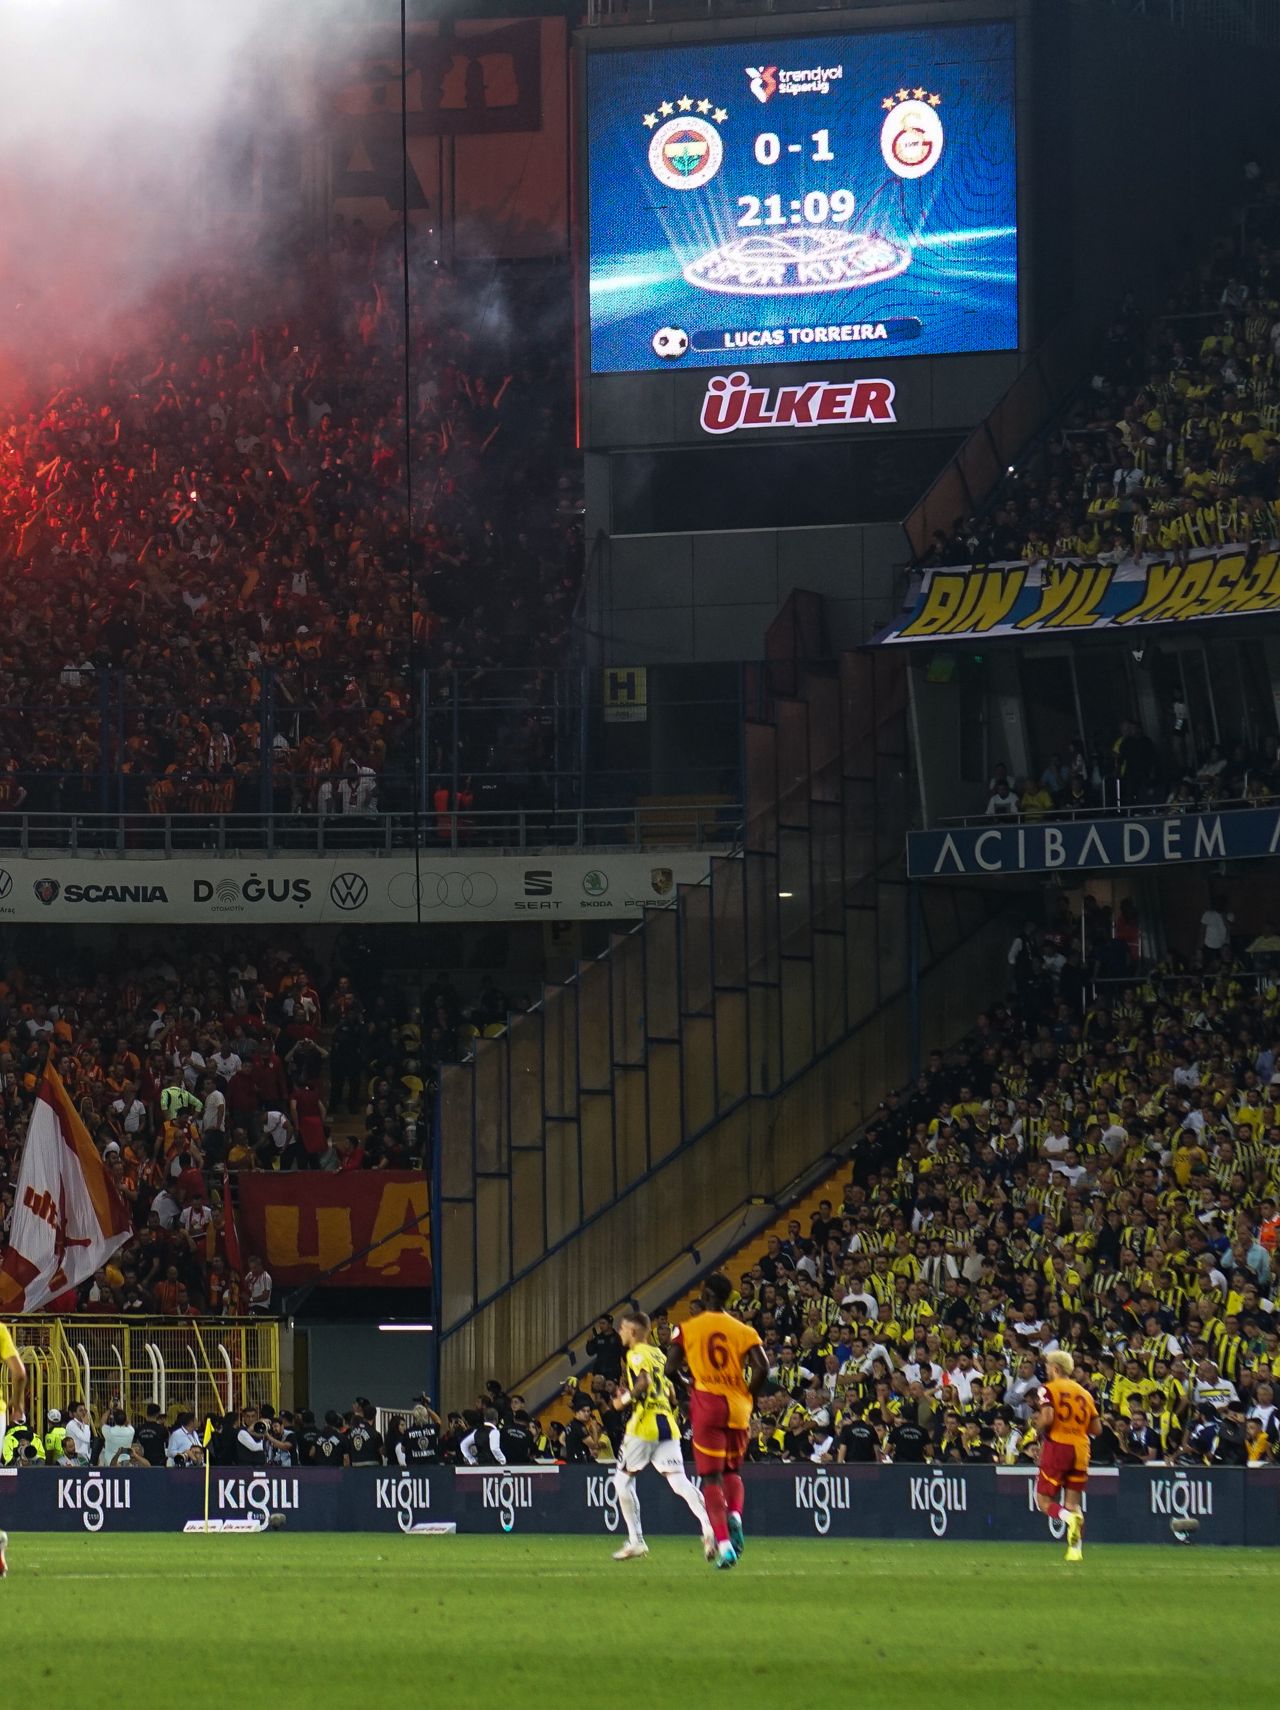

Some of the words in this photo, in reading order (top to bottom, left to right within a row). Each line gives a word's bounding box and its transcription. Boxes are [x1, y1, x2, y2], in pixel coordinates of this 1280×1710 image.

[754, 132, 780, 166] 0
[812, 129, 835, 161] 1
[737, 188, 855, 227] 21:09
[724, 331, 785, 348] LUCAS
[788, 323, 888, 344] TORREIRA
[700, 371, 897, 434] ÜLKER
[609, 671, 635, 700] H
[933, 815, 1227, 874] ACIBADEM
[63, 884, 169, 903] SCANIA
[514, 901, 563, 910] SEAT
[707, 1331, 728, 1370] 6
[1056, 1391, 1087, 1424] 53
